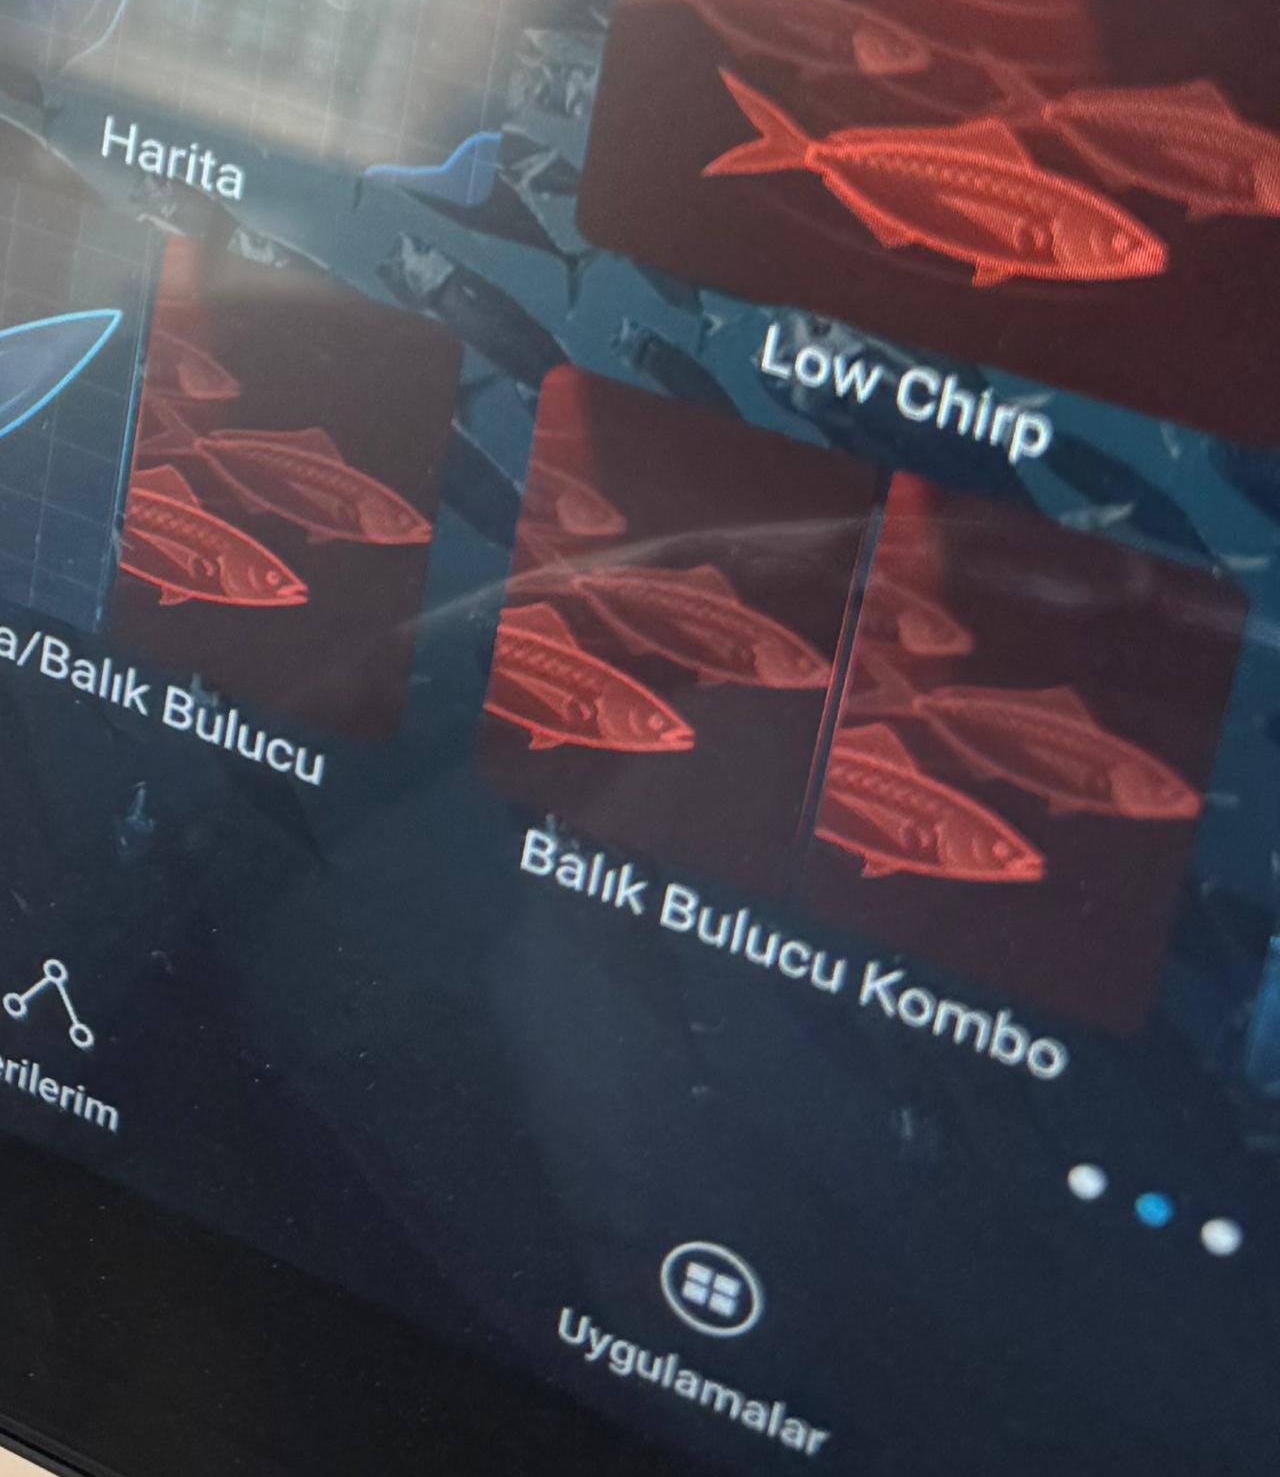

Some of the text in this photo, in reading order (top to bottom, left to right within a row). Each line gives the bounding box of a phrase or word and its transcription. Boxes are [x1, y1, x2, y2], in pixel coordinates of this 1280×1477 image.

[100, 113, 247, 201] Harita
[760, 322, 1053, 465] Low Chirp
[161, 684, 326, 786] Bulucu
[519, 828, 1070, 1081] Balık Bulucu Kombo
[556, 1305, 831, 1457] Uygulamalar
